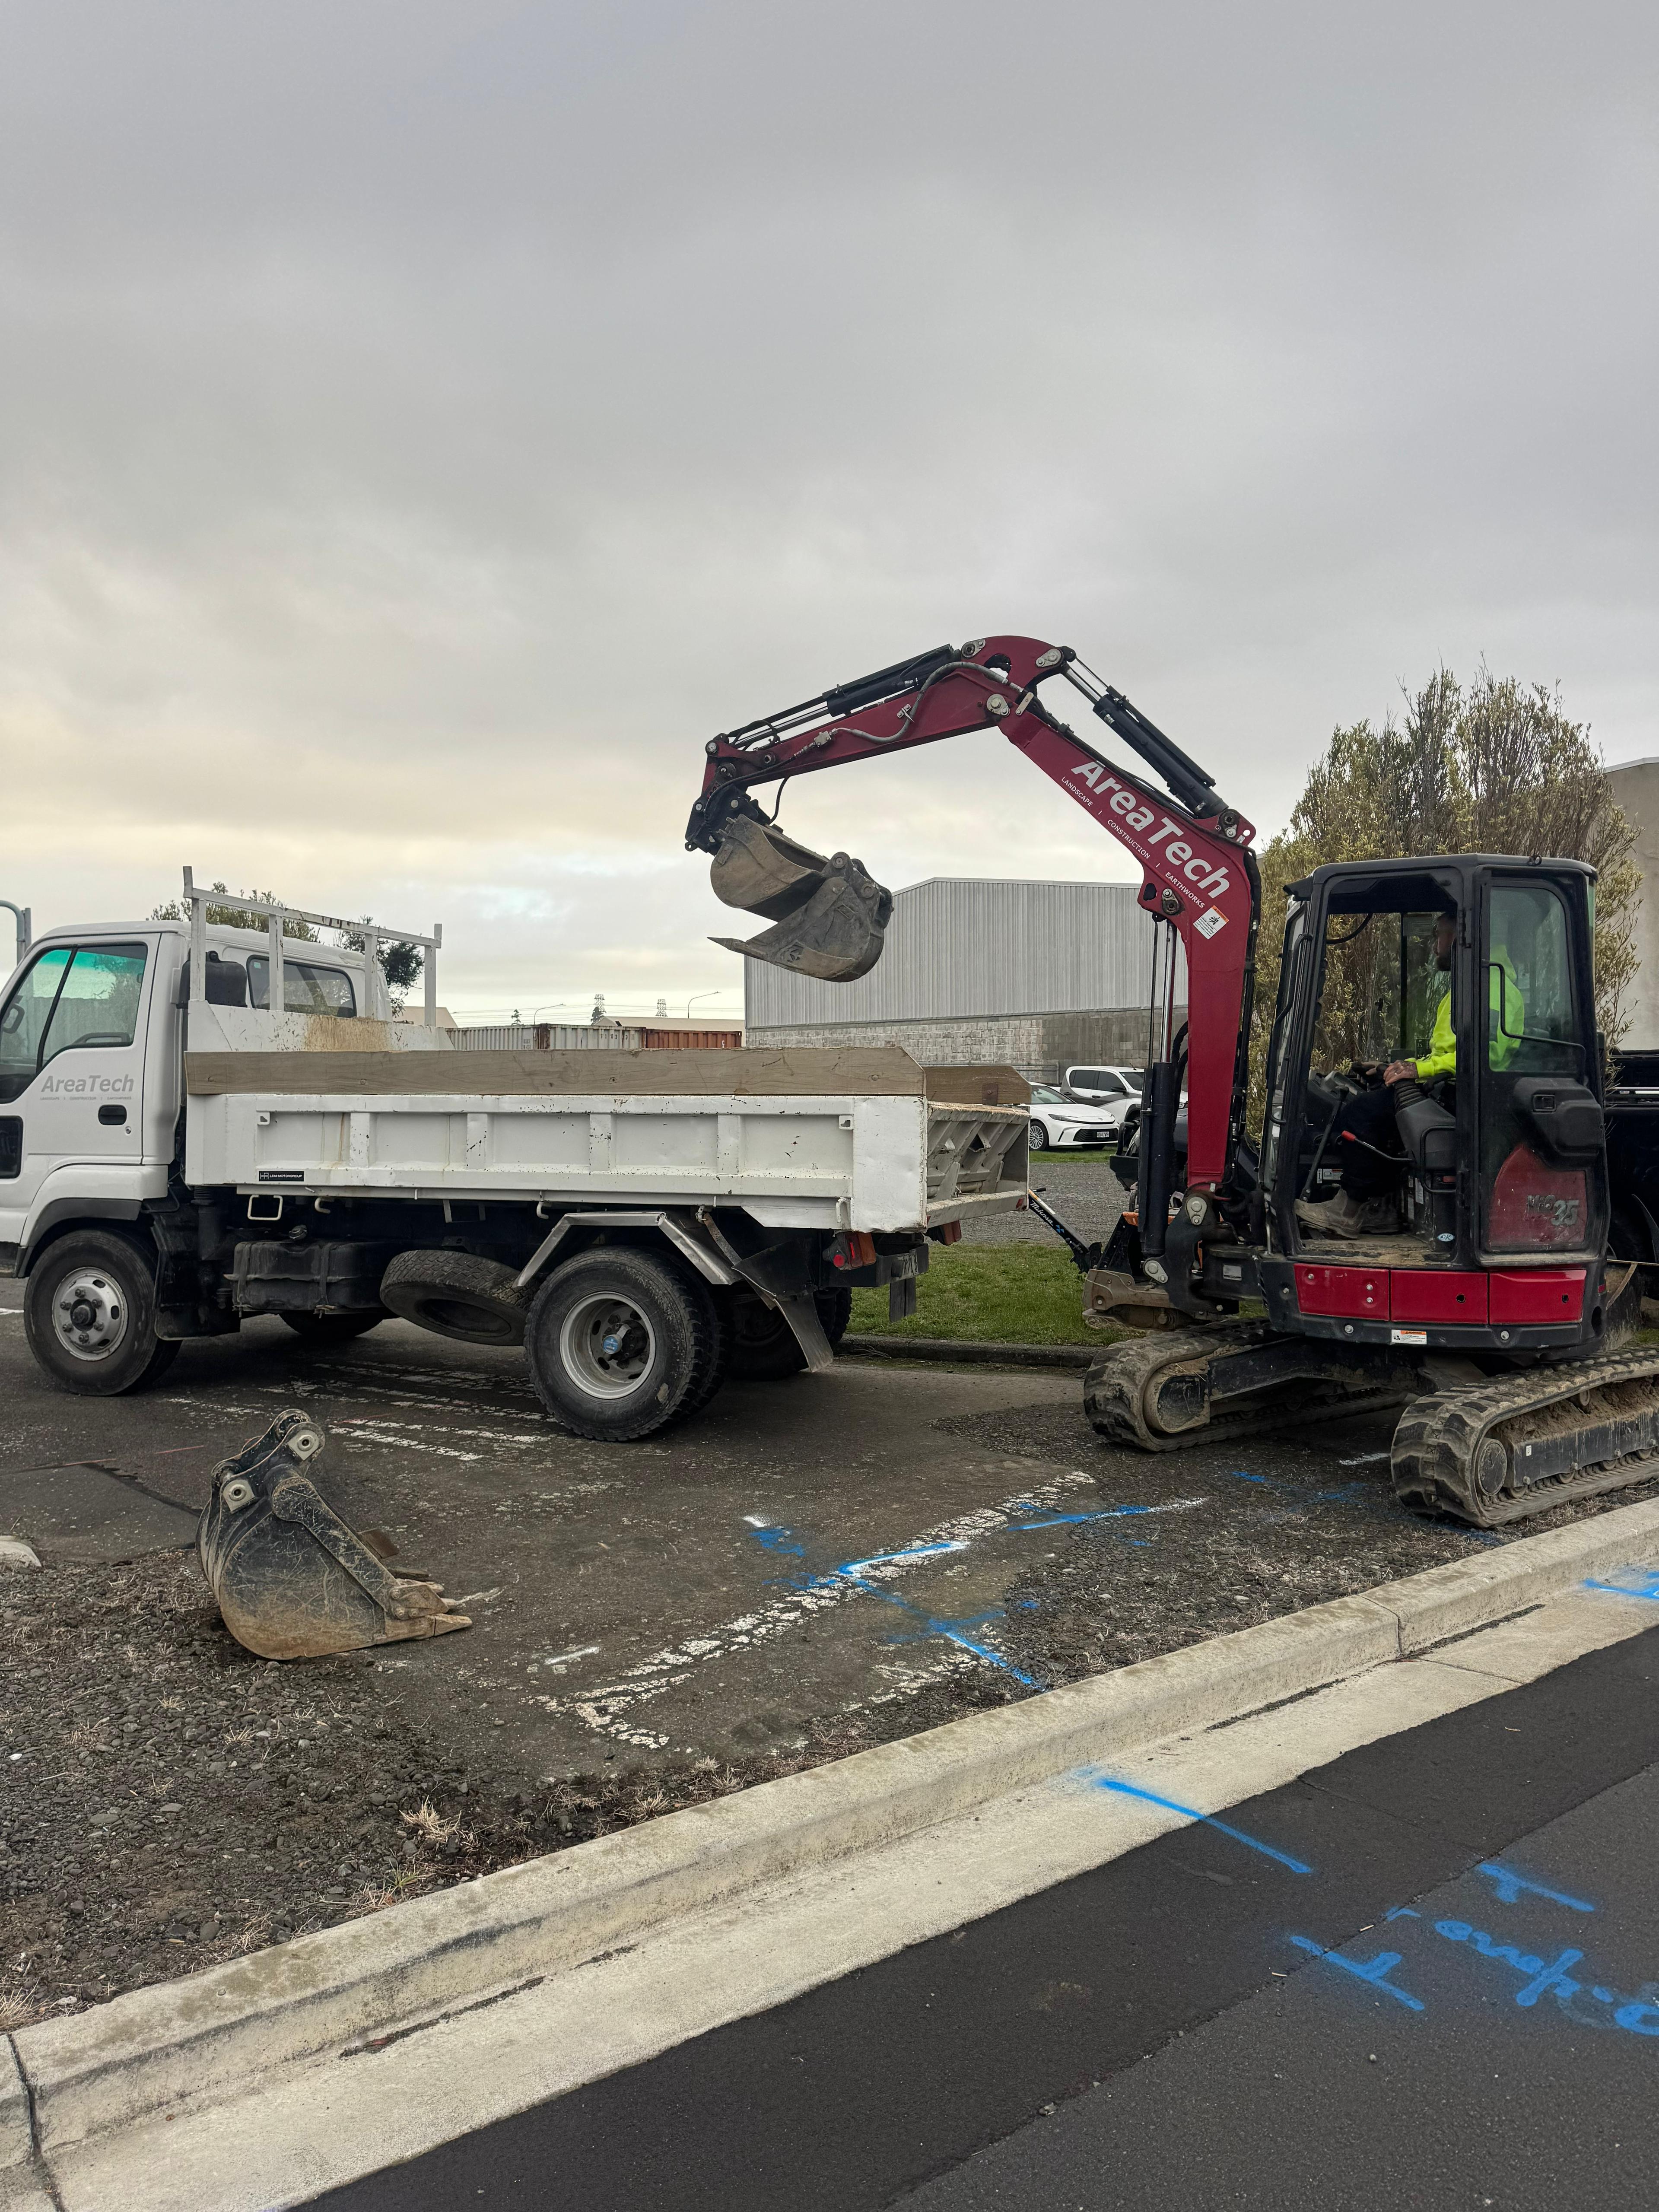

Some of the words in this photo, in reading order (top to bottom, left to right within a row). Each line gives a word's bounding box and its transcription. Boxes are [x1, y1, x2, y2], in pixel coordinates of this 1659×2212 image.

[1061, 776, 1093, 807] LANDSCAPE
[1107, 820, 1150, 859] CONSTRUCTION
[1165, 872, 1205, 908] EARTHWORKS
[1071, 761, 1230, 899] AreaTech
[41, 1074, 134, 1092] AreaTech
